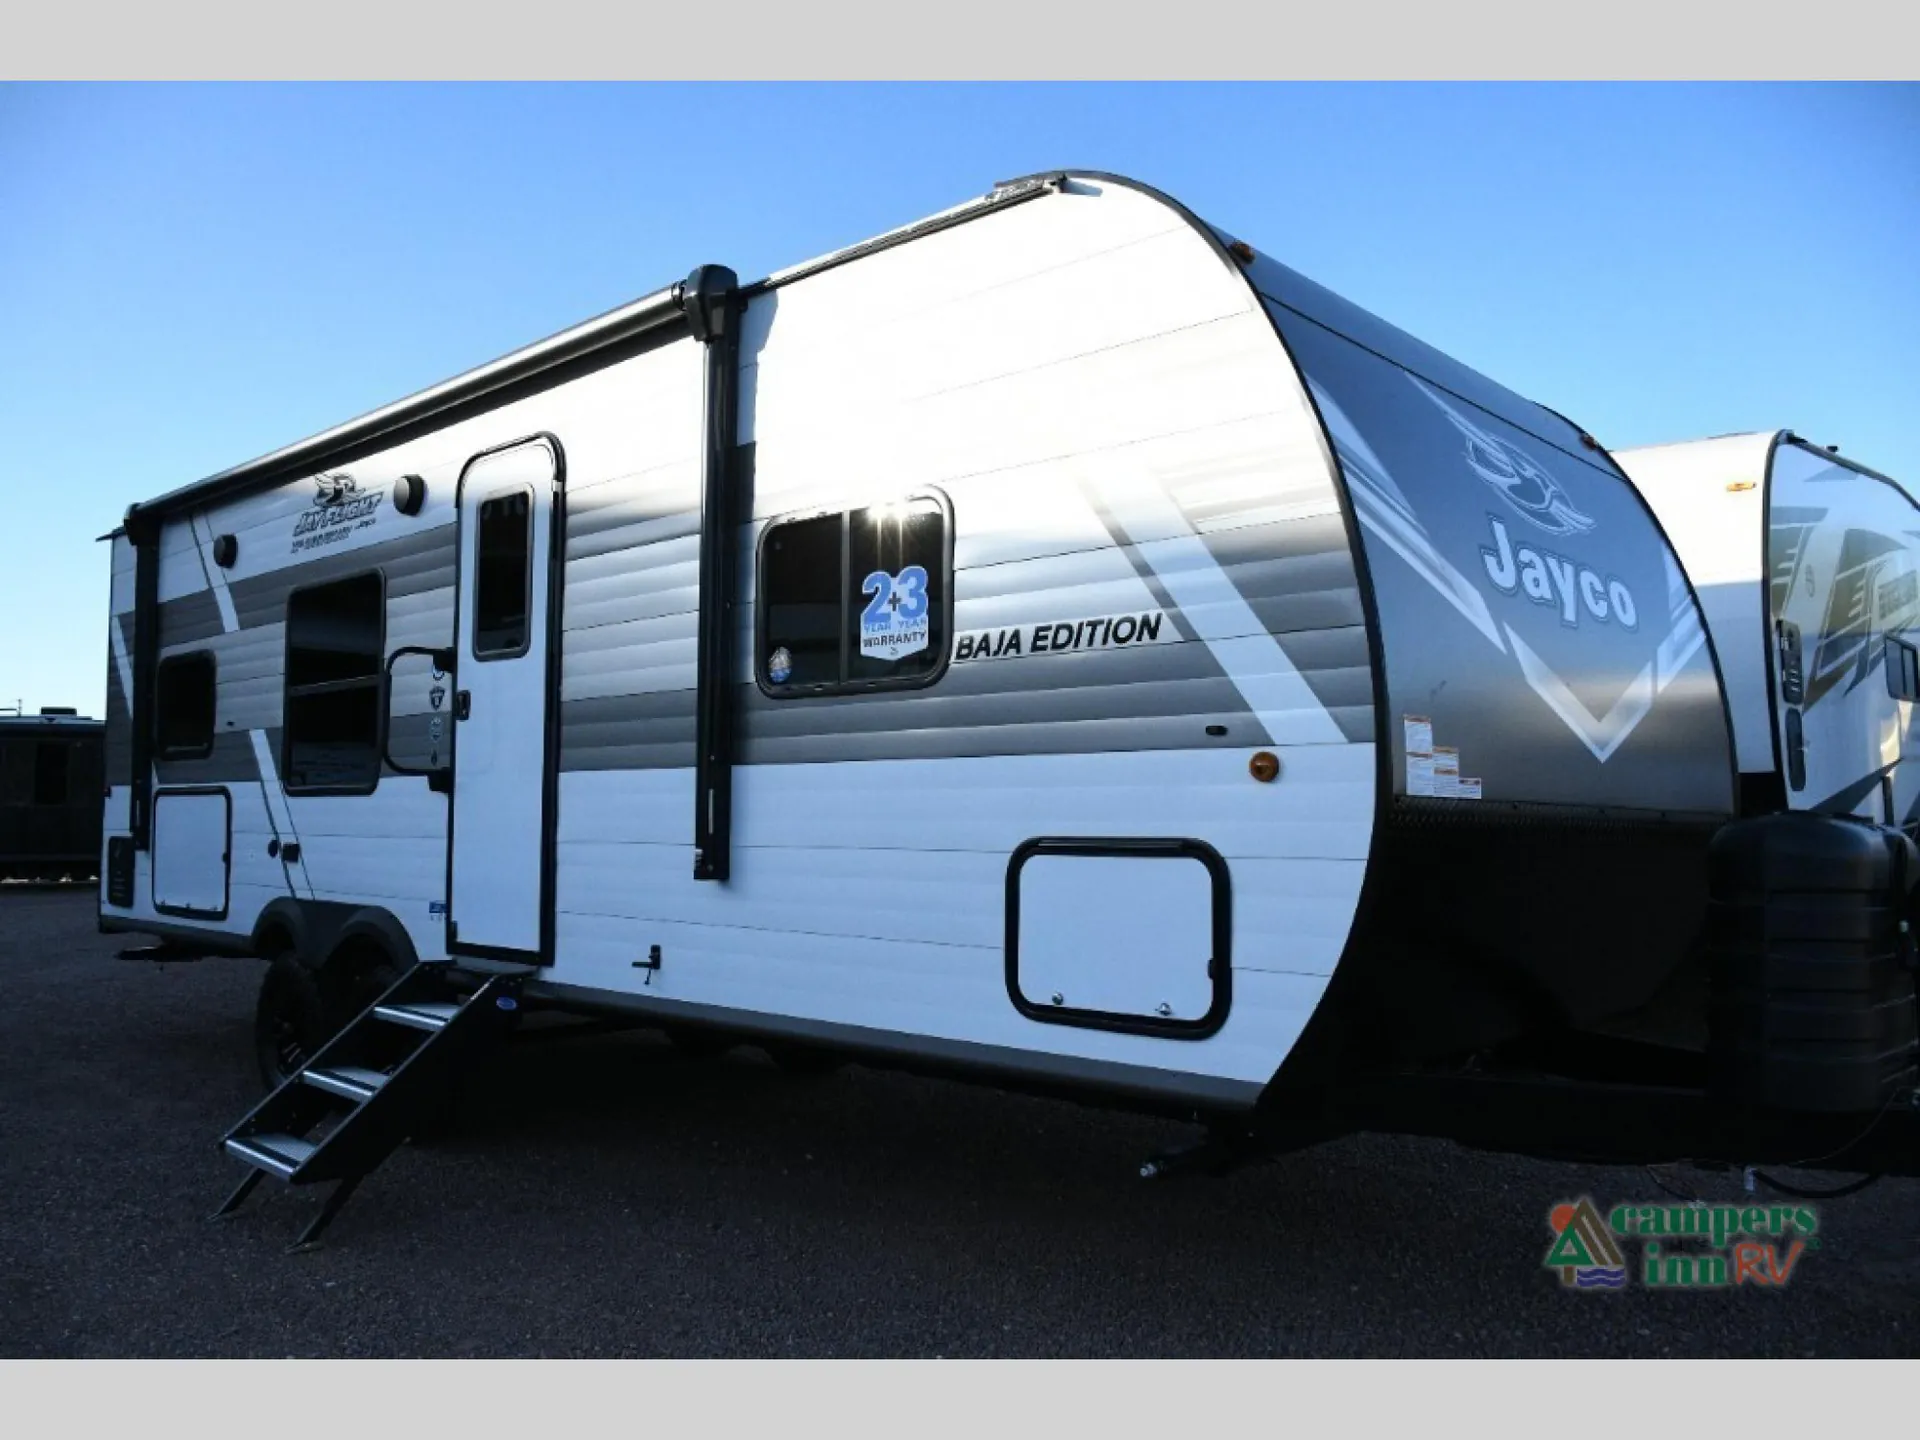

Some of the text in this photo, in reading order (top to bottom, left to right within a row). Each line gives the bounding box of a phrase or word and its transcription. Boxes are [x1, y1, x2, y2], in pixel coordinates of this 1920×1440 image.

[1480, 514, 1638, 630] Jayco
[863, 631, 926, 648] WARRANTY
[955, 613, 1162, 660] BAJA EDITION
